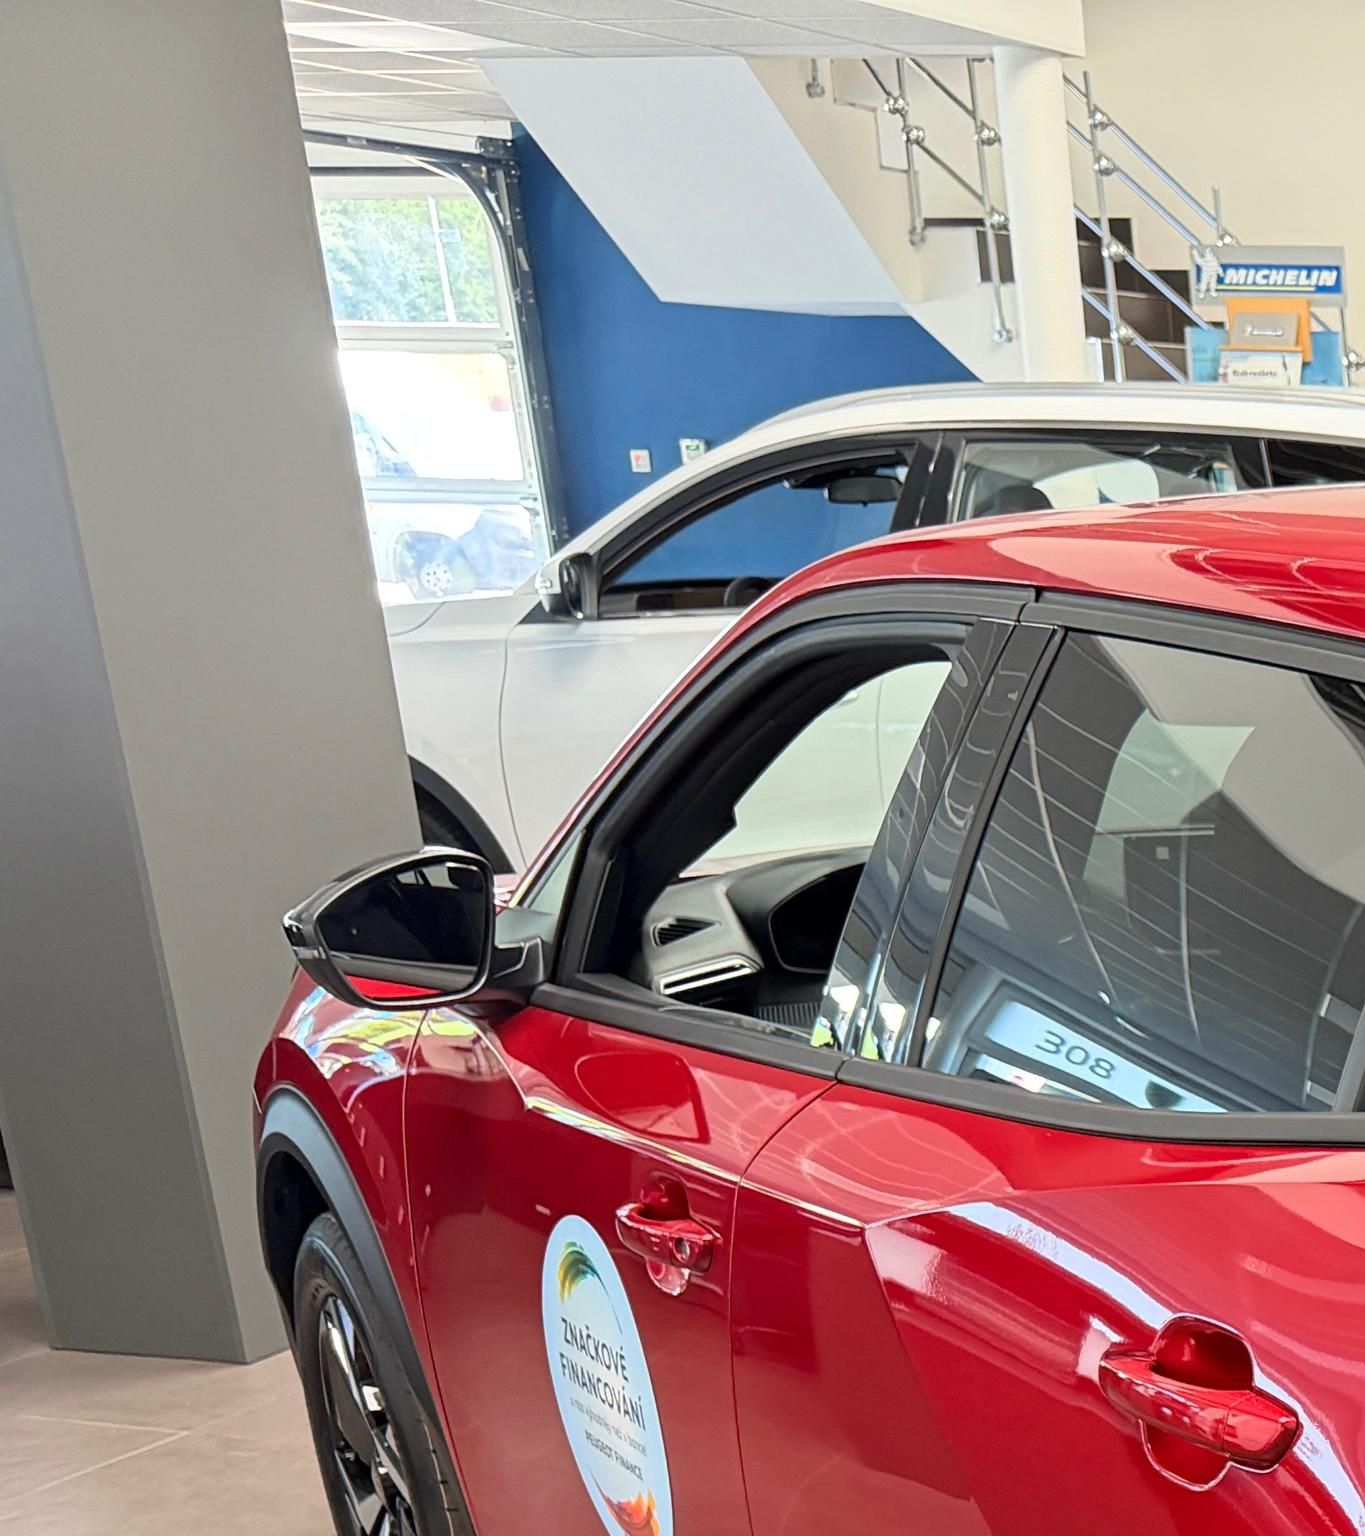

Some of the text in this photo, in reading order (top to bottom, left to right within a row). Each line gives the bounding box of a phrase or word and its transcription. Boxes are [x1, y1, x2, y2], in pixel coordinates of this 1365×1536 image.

[1223, 267, 1338, 287] MICHELIN
[1034, 1029, 1116, 1079] 308
[561, 1316, 629, 1381] ZNAČKOVÉ
[559, 1352, 645, 1431] FINANCOVÁNÍ
